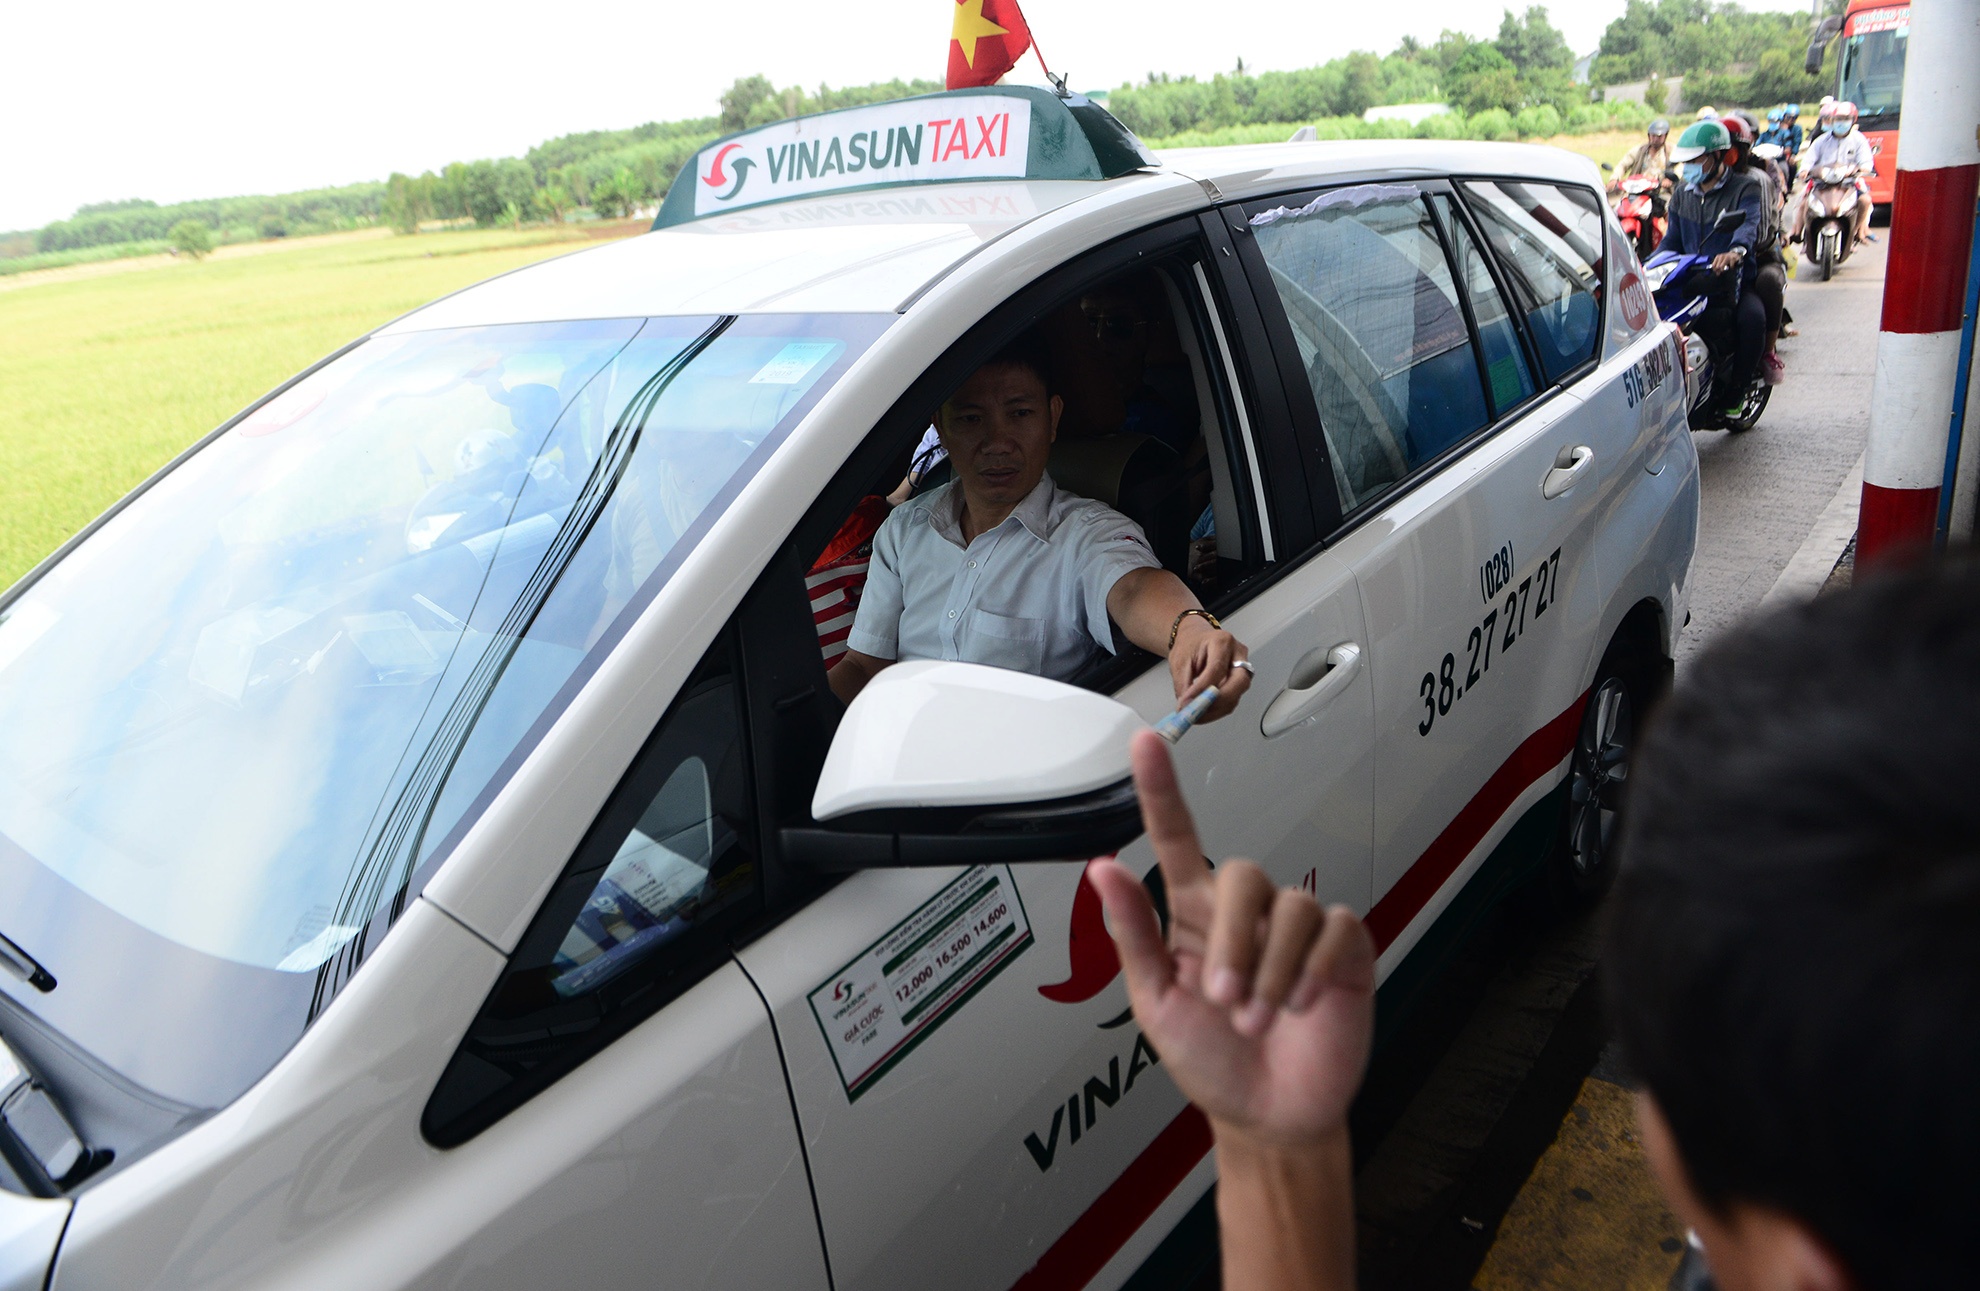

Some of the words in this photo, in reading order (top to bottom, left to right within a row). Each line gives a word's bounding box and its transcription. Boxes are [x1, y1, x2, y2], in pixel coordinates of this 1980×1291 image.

[766, 124, 923, 184] VINASUN
[927, 112, 1010, 162] TAXI
[1622, 363, 1645, 409] 51G
[1480, 540, 1514, 604] (028)
[1418, 608, 1498, 737] 38.27
[1502, 575, 1532, 654] 27
[1535, 546, 1561, 620] 27
[973, 903, 1008, 937] 14.600
[935, 933, 971, 970] 16.500
[895, 965, 934, 1002] 12.000
[1023, 1032, 1160, 1174] VINA
